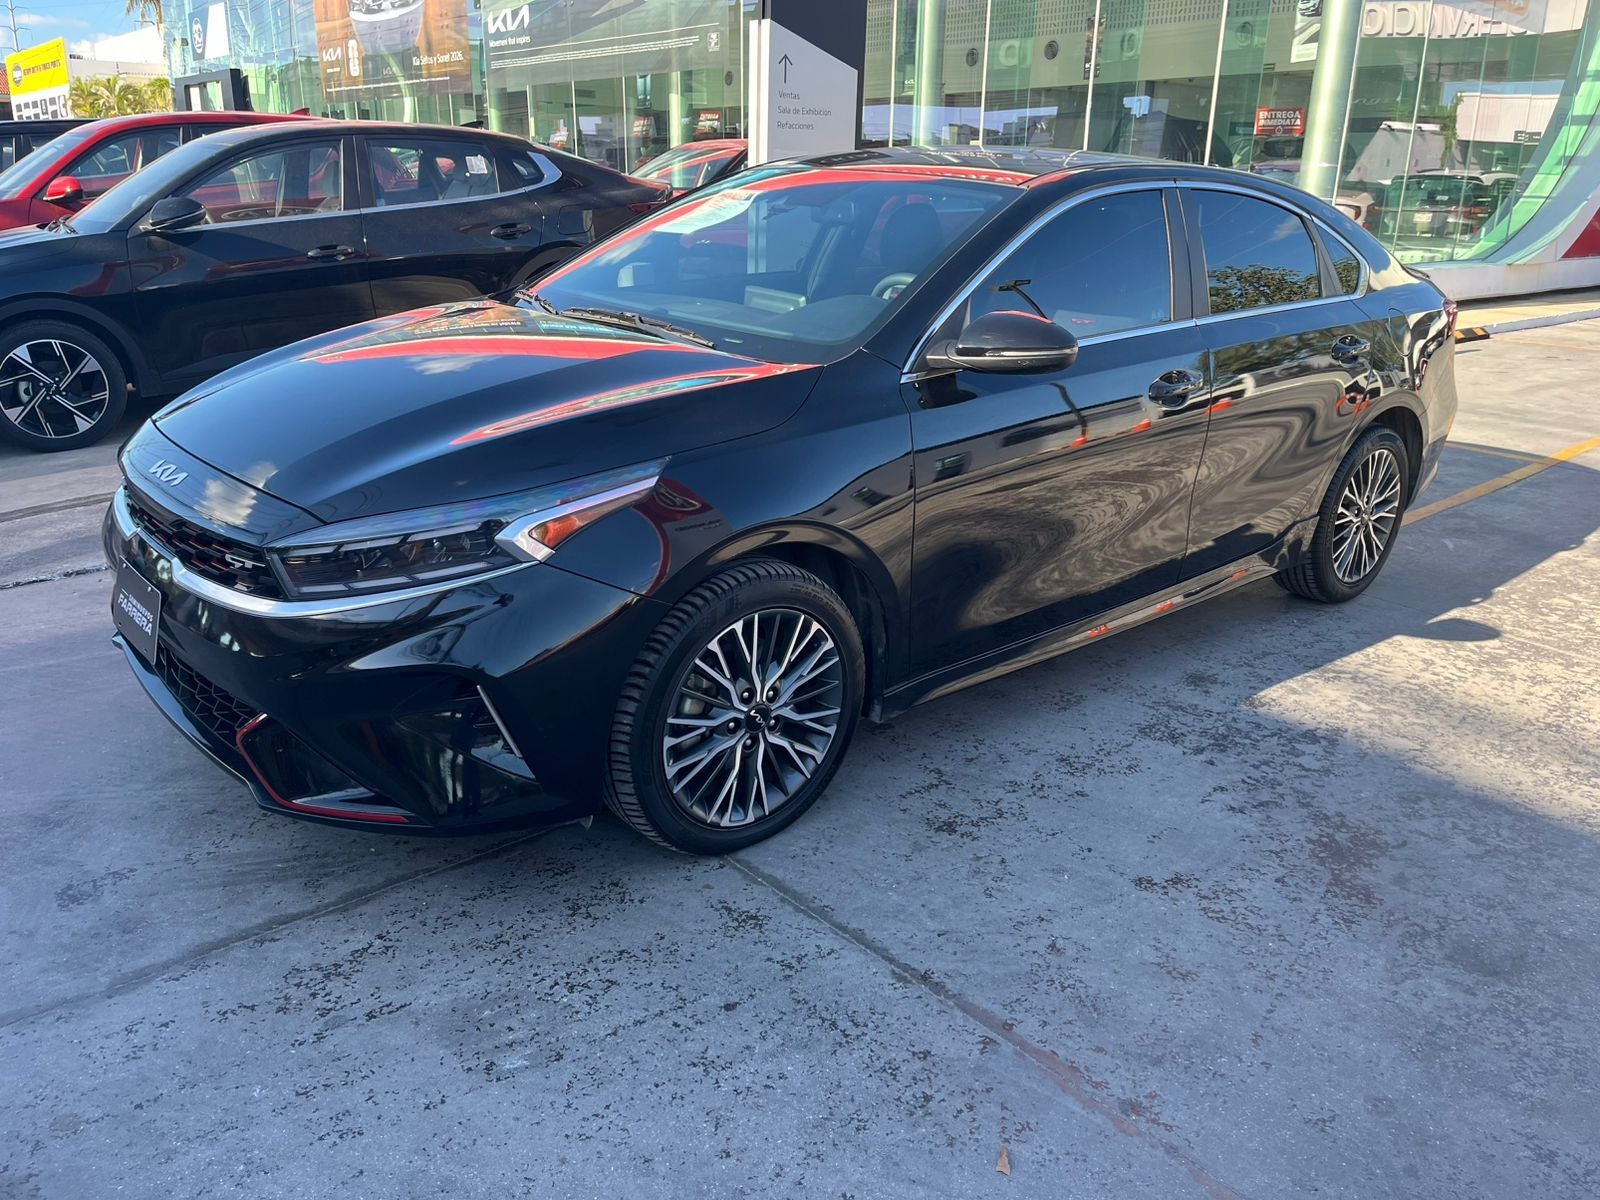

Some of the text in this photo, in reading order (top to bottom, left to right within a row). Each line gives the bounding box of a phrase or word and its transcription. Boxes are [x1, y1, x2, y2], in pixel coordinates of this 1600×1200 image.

[488, 5, 530, 34] KIA
[322, 47, 342, 62] KIA
[778, 89, 801, 100] Ventas
[777, 105, 791, 115] Sala
[792, 106, 800, 115] de
[1259, 110, 1302, 119] ENTREGA
[776, 121, 814, 130] Refacciones
[1258, 118, 1302, 127] INMEDIATA
[149, 458, 189, 488] KIA
[118, 593, 153, 636] FARRERA
